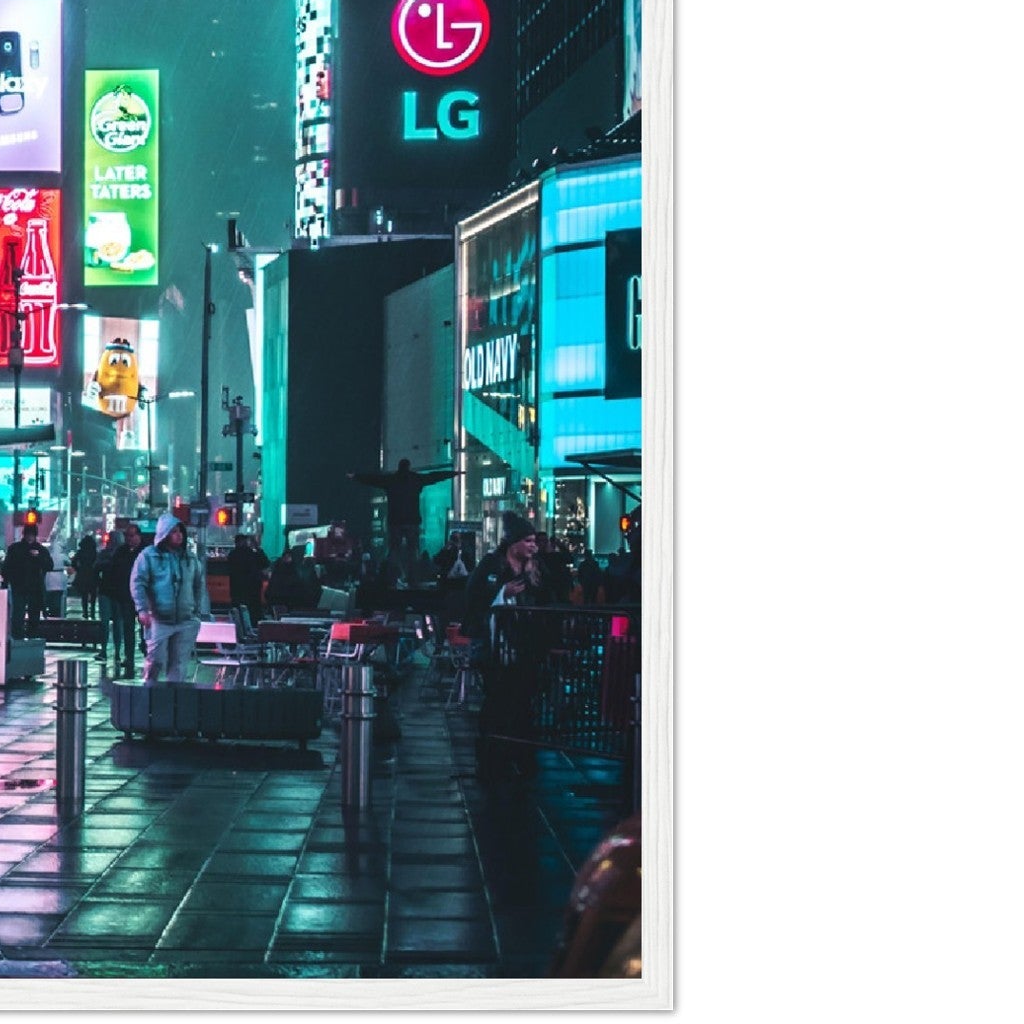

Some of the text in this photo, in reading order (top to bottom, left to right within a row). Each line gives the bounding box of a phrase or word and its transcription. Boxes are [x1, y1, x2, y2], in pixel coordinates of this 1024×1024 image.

[403, 89, 480, 140] LG
[94, 165, 147, 182] LATER
[90, 184, 152, 200] TATERS
[464, 333, 518, 390] OLD NAVY
